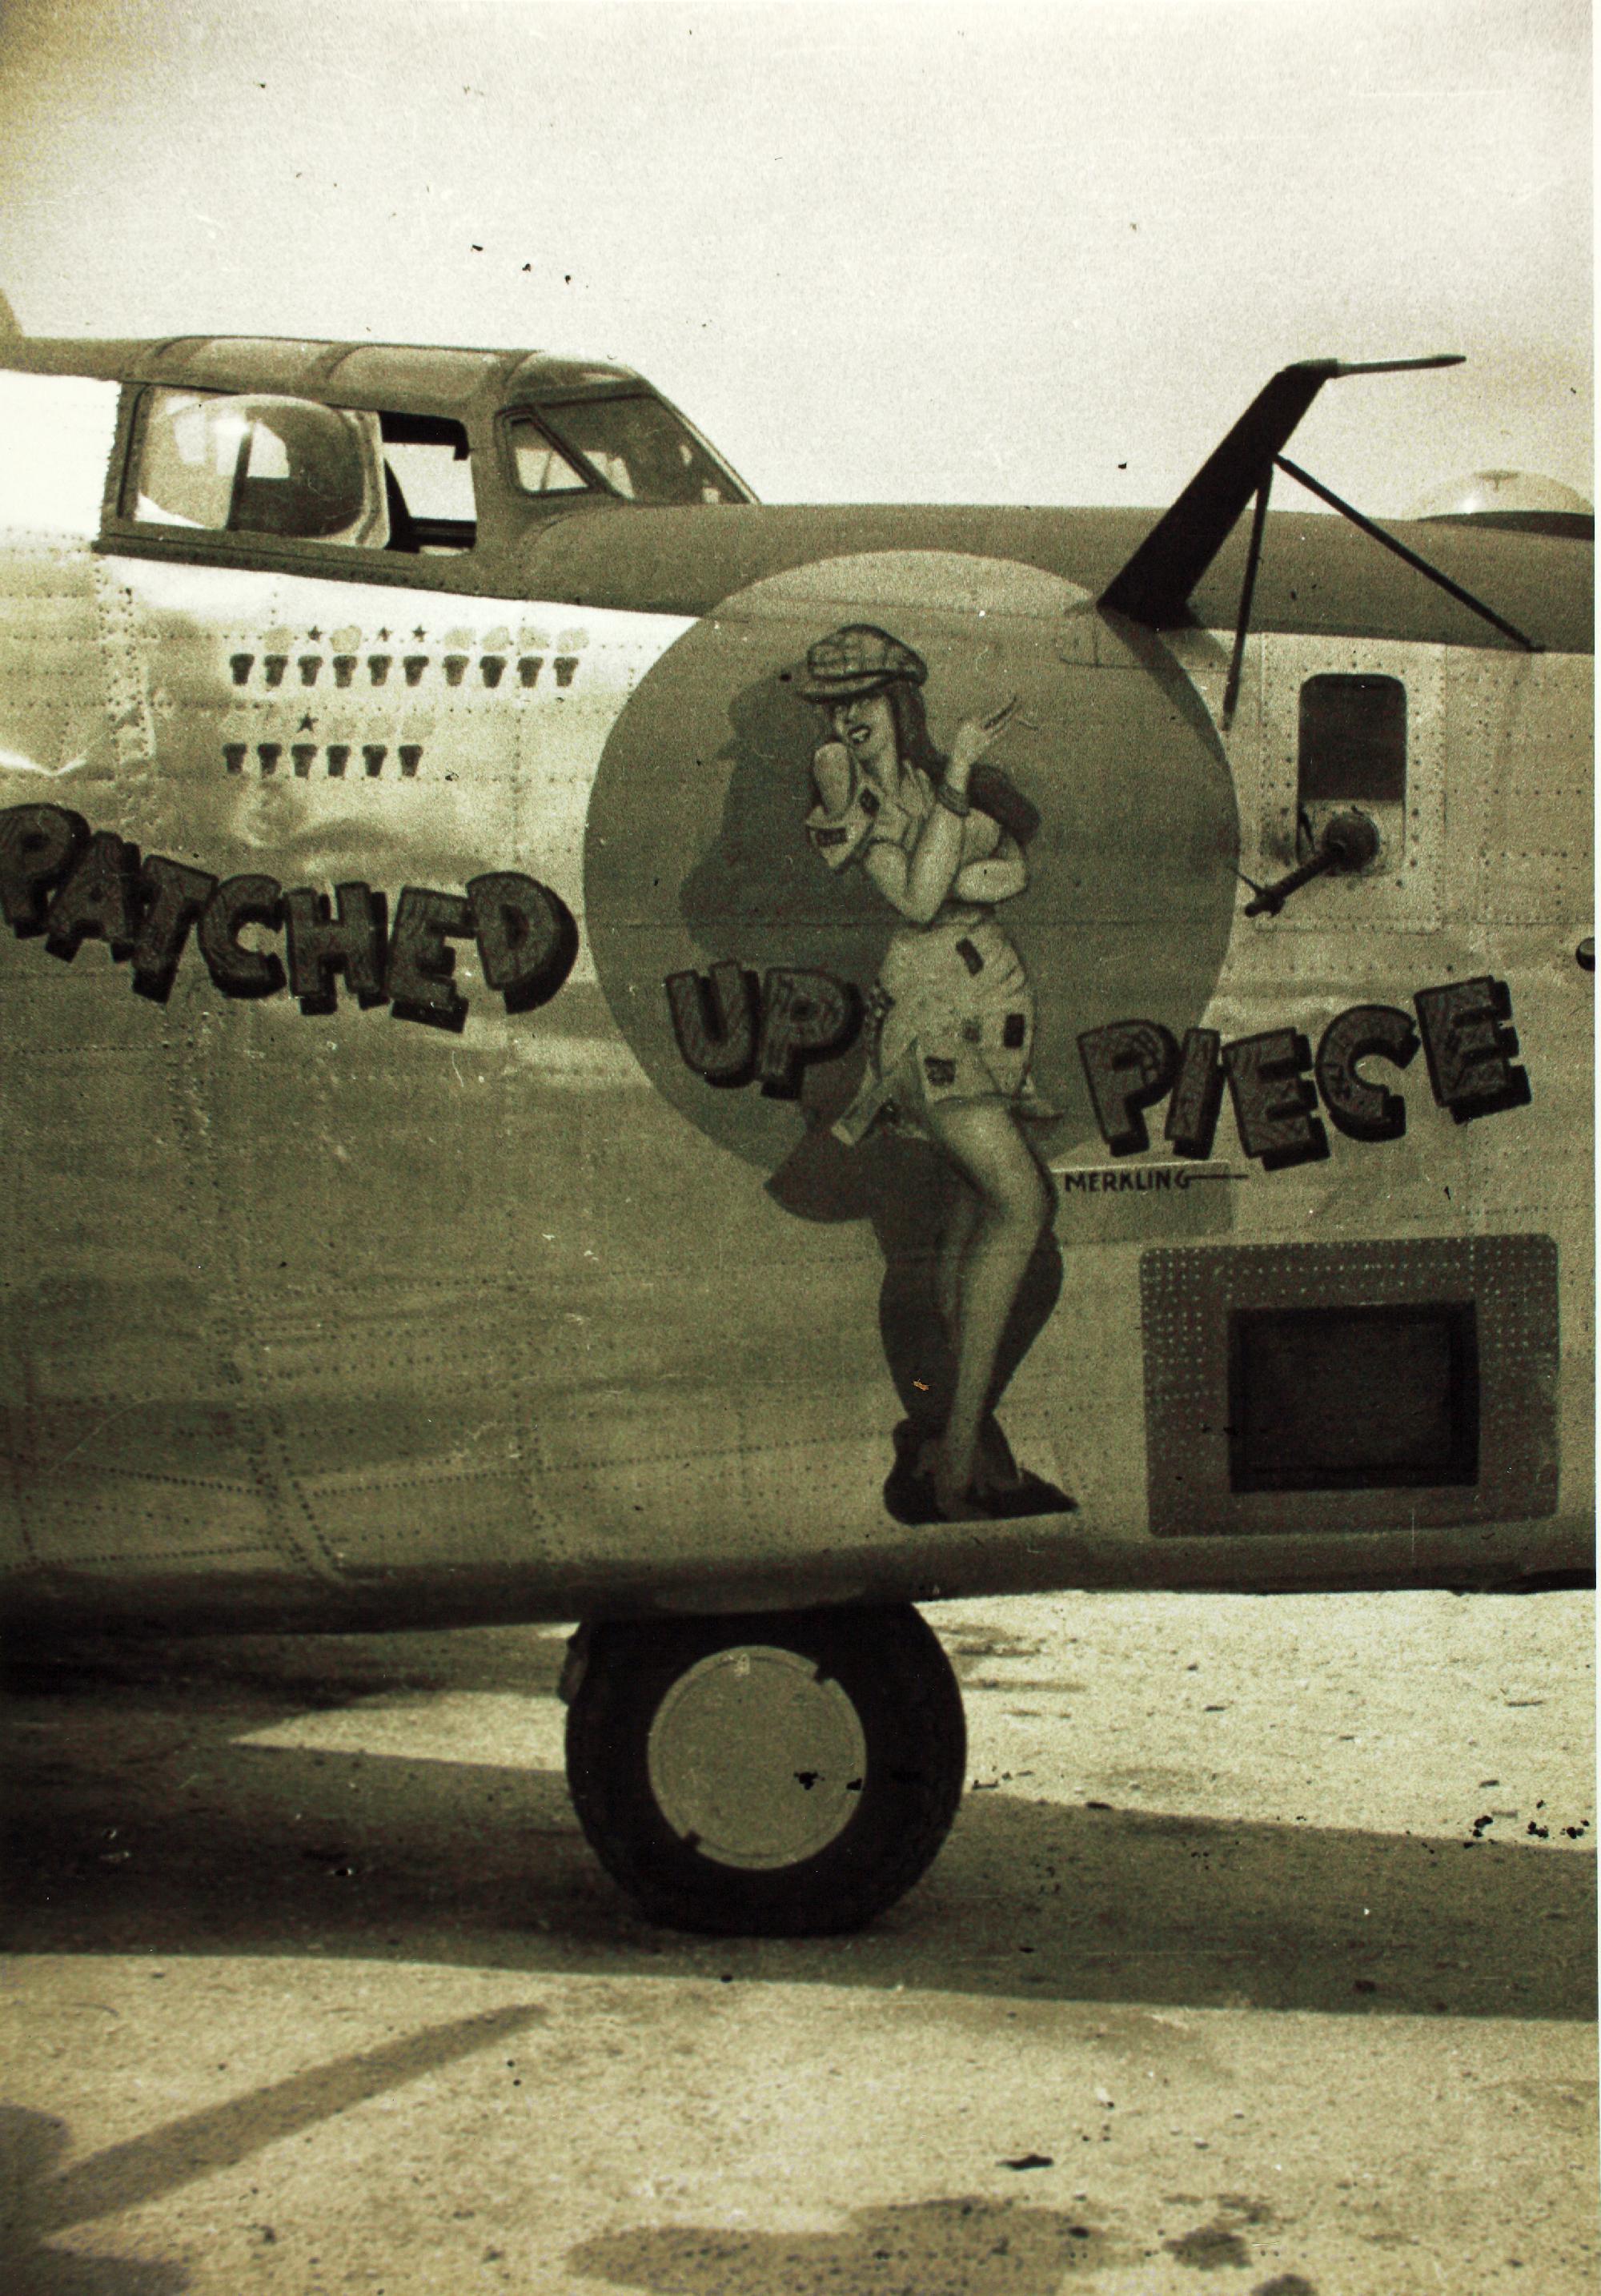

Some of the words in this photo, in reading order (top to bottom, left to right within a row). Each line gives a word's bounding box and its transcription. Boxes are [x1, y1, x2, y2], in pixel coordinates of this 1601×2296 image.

[0, 803, 579, 1034] PATCHED
[665, 961, 864, 1100] UP
[1076, 975, 1532, 1171] PIECE
[1065, 1169, 1192, 1192] MERKLING
